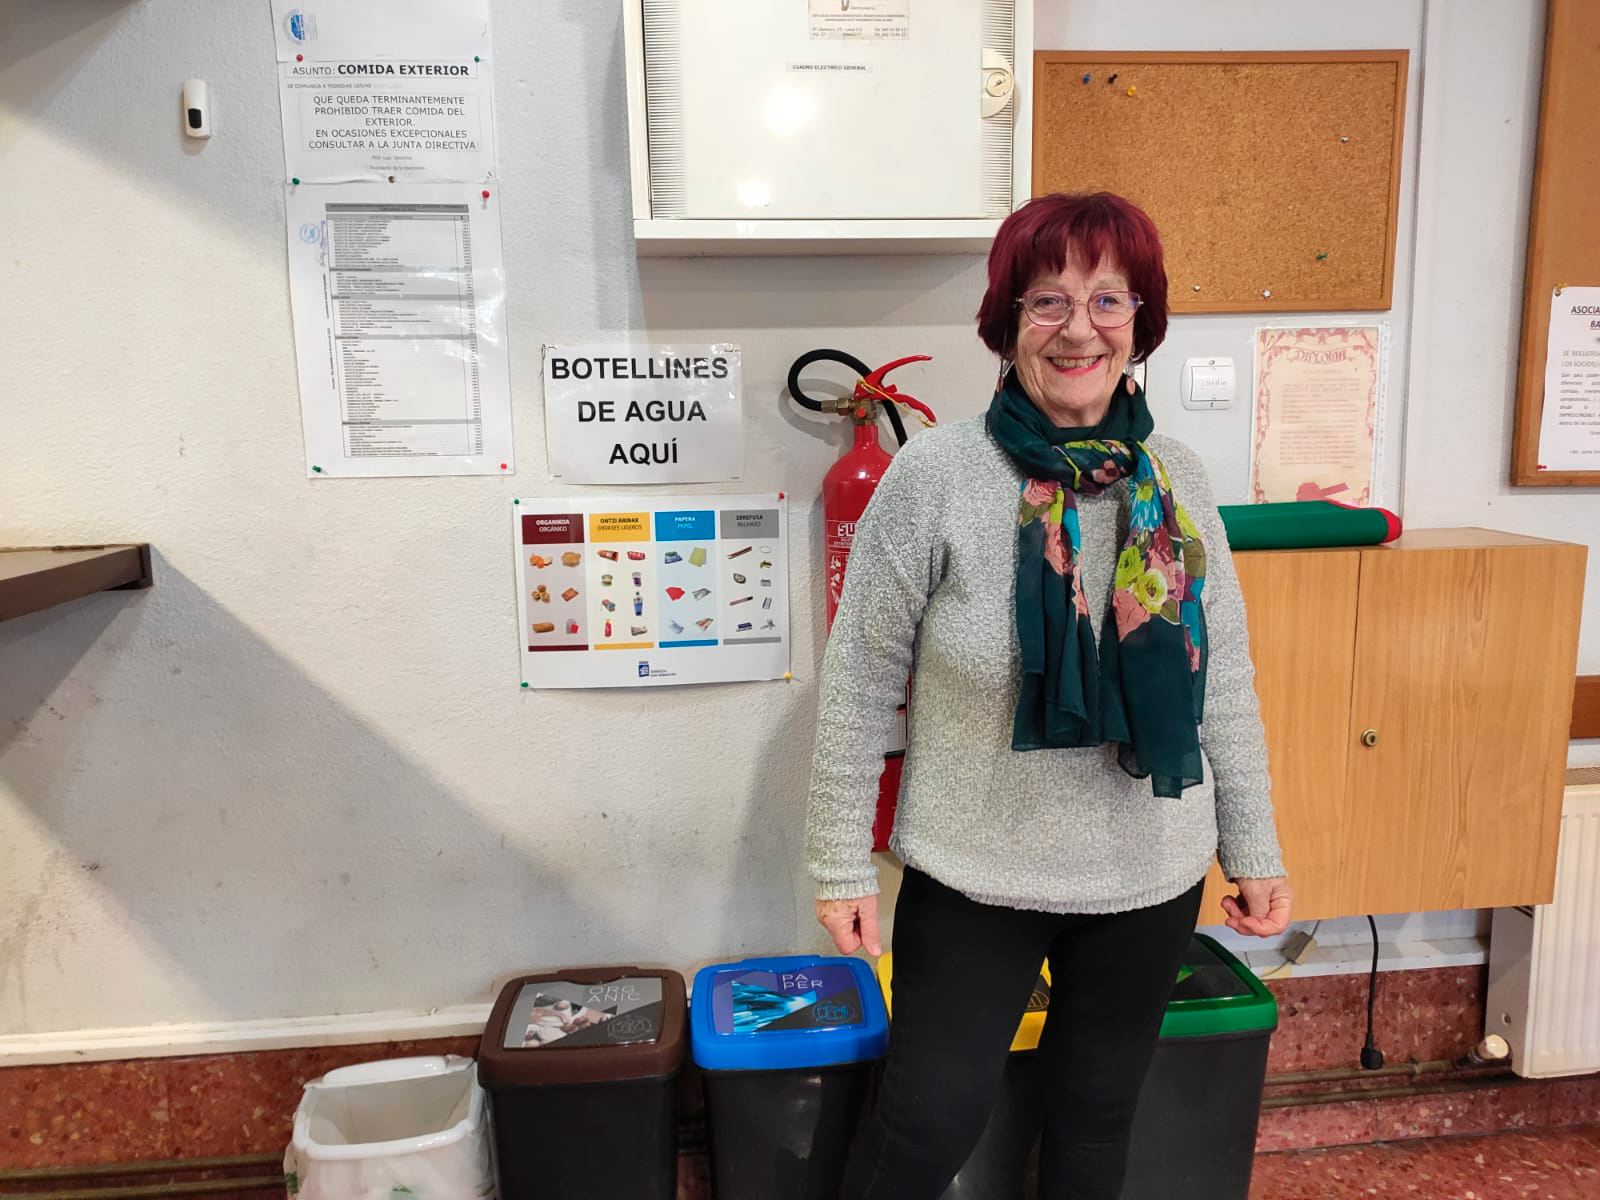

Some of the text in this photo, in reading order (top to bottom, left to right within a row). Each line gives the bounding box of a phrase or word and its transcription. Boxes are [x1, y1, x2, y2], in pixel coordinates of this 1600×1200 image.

[293, 64, 469, 76] ASUNTO: COMIDA EXTERIOR
[313, 96, 465, 105] QUE QUEDA TERMINANTEMENTE
[315, 106, 465, 116] PROHIBIDO TRAER COMIDA DEL
[315, 129, 468, 139] EN OCASIONES EXCEPCIONALES
[308, 140, 476, 150] CONSULTAR A LA JUNTA DIRECTIVA
[551, 357, 729, 379] BOTELLINES
[578, 400, 707, 422] DE AGUA
[608, 437, 678, 466] AQUÍ
[782, 973, 809, 982] PA
[783, 980, 823, 991] PER
